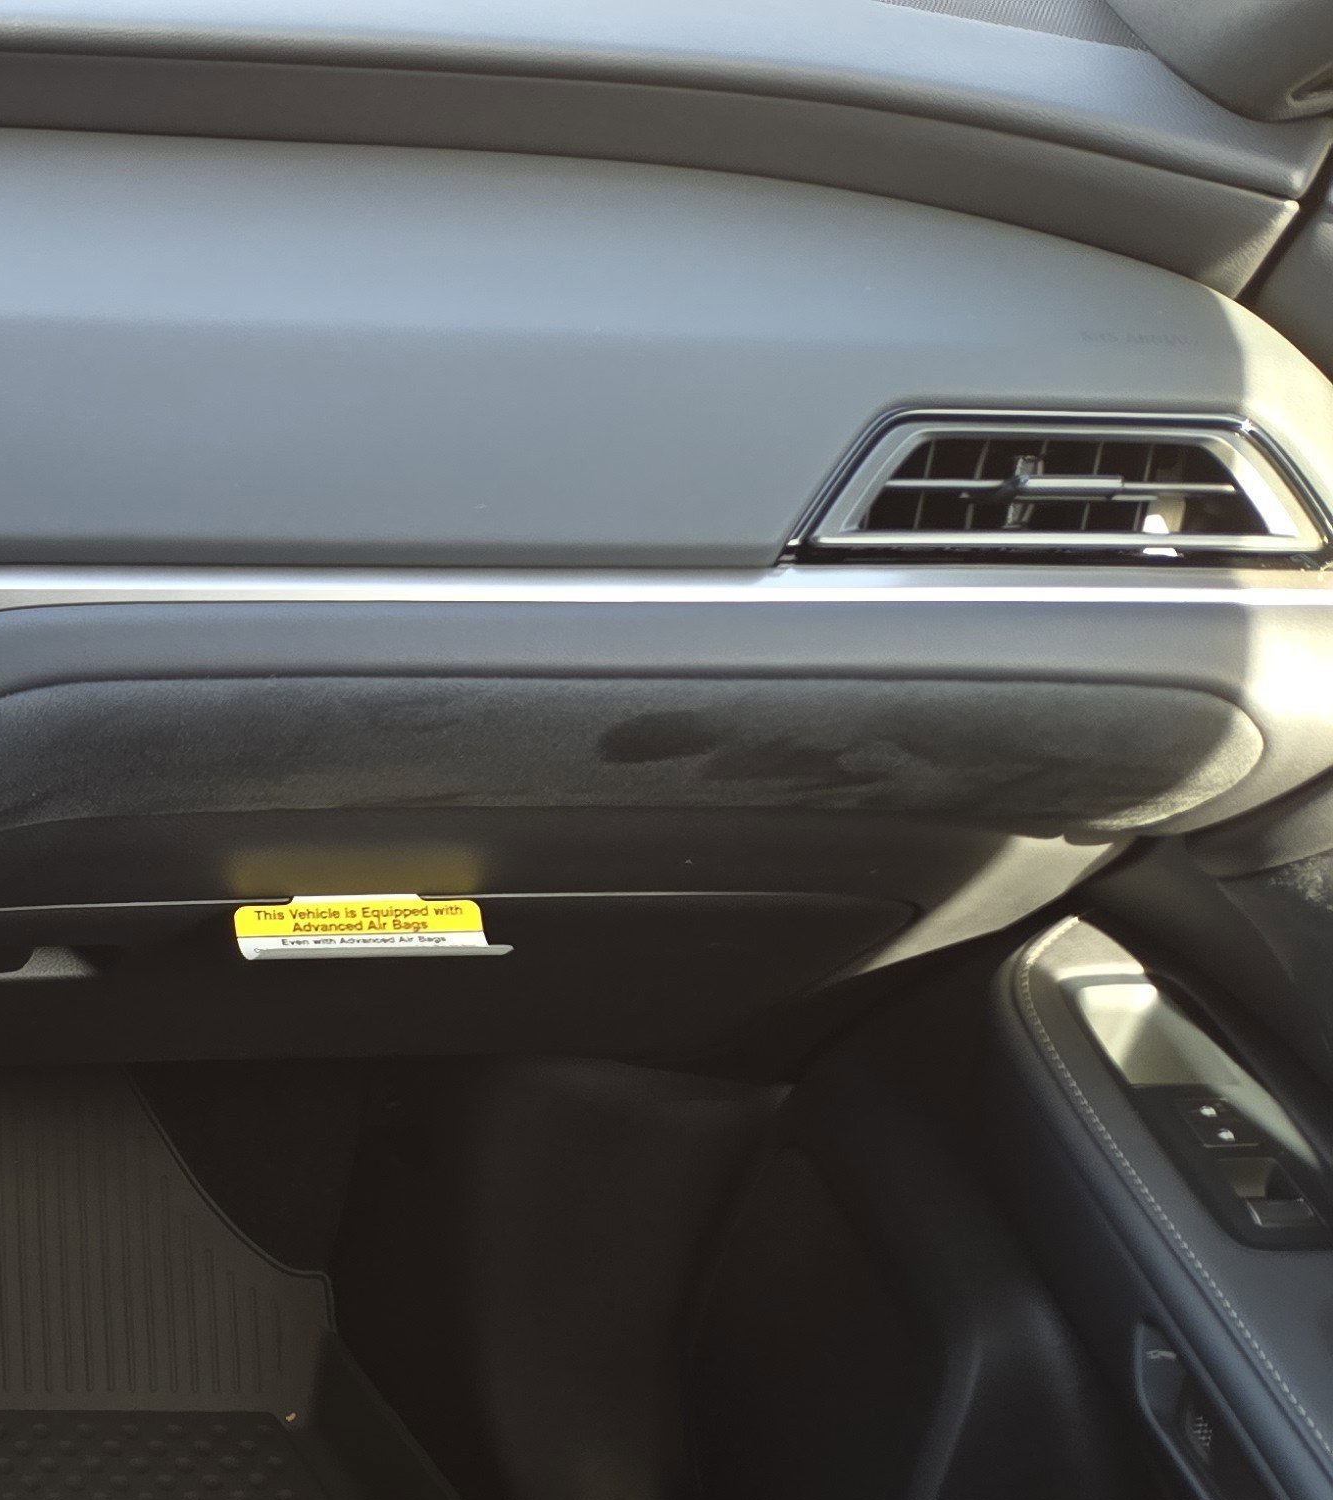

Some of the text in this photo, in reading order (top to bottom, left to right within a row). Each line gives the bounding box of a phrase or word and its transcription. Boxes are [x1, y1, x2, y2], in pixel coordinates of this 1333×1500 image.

[255, 906, 463, 921] This Vehicle is Equipped with
[292, 919, 428, 932] Advanced Air Bags
[281, 938, 309, 946] Even
[314, 937, 336, 945] with
[339, 936, 395, 945] Advanced
[418, 935, 447, 944] Bags
